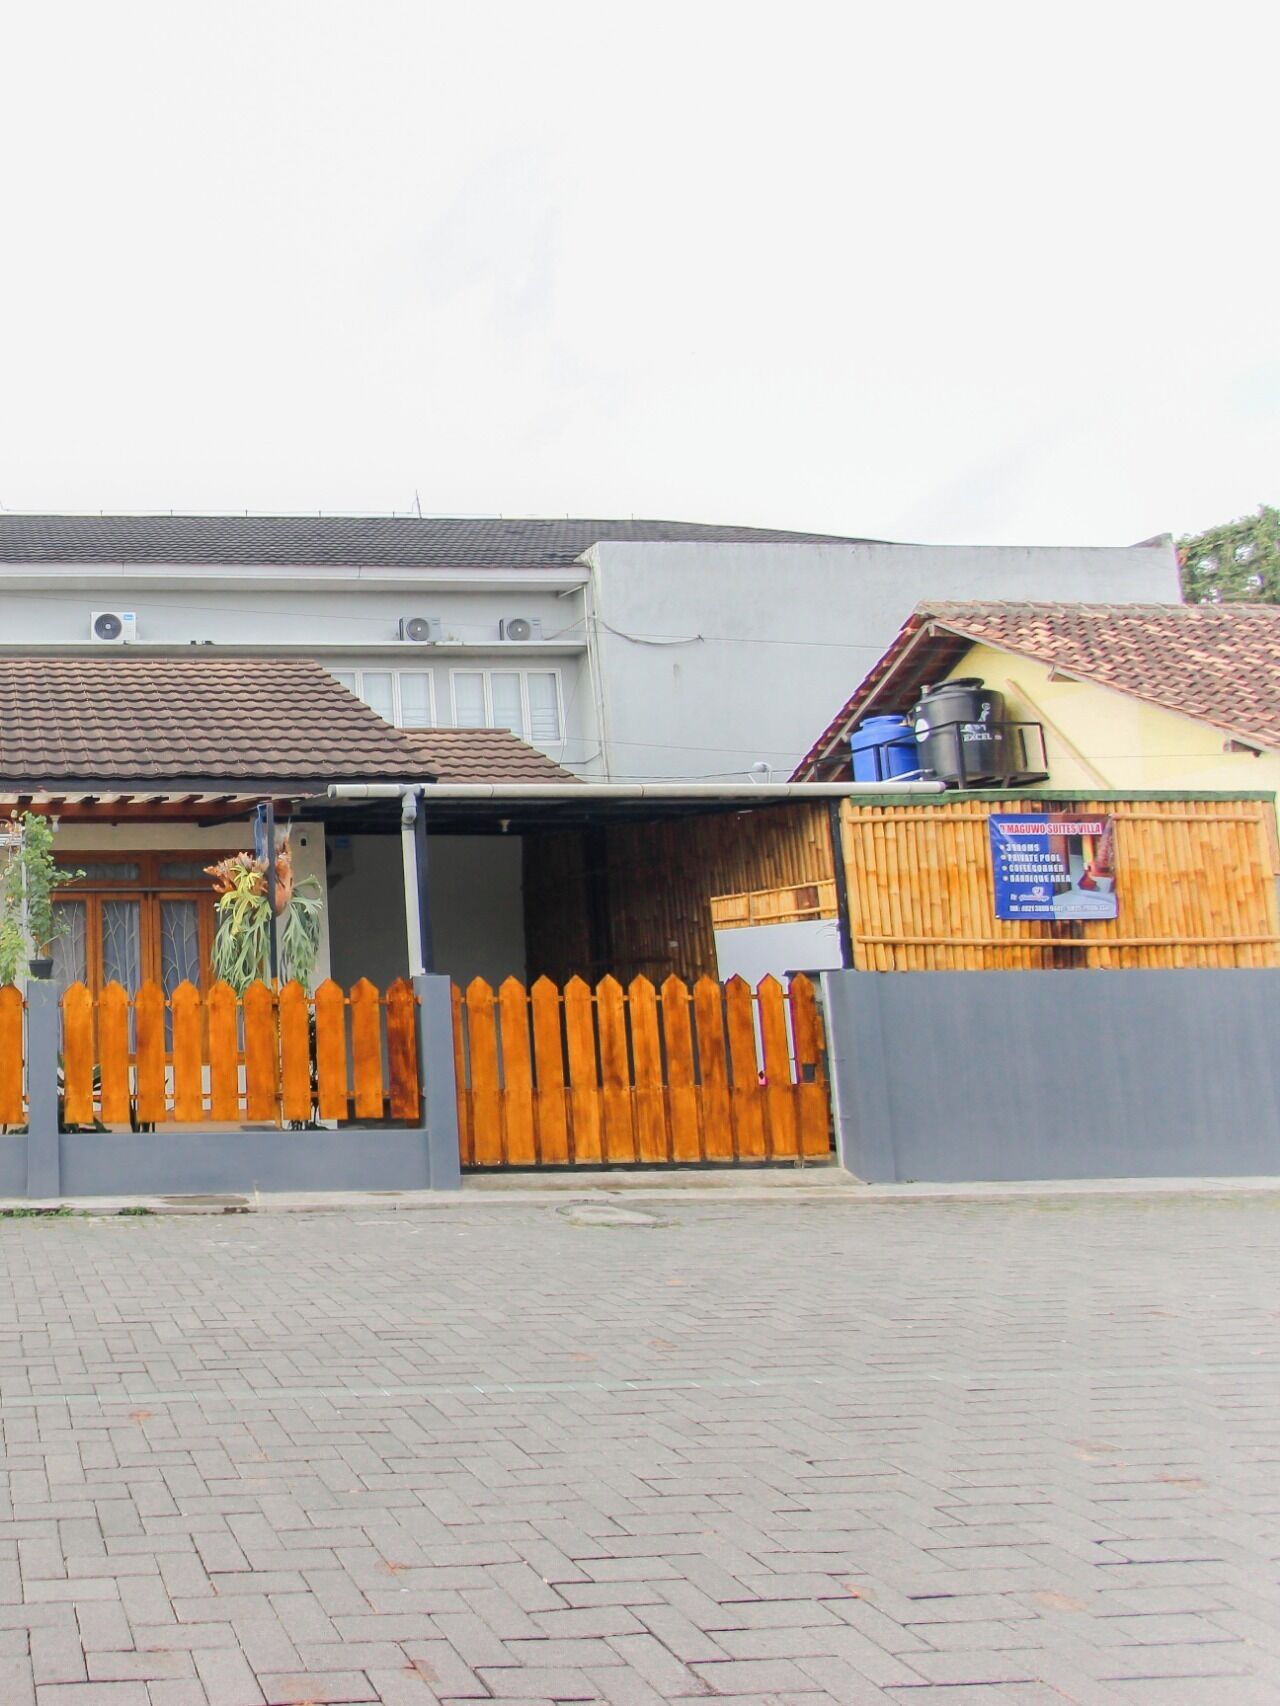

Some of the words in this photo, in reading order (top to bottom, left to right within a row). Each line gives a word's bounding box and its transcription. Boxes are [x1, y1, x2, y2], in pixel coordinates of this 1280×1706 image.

[964, 733, 992, 742] EXCEL
[1047, 824, 1076, 834] SUITES
[1078, 824, 1100, 834] VILLA
[1008, 854, 1039, 862] PRIVATE
[1040, 854, 1061, 862] POOL
